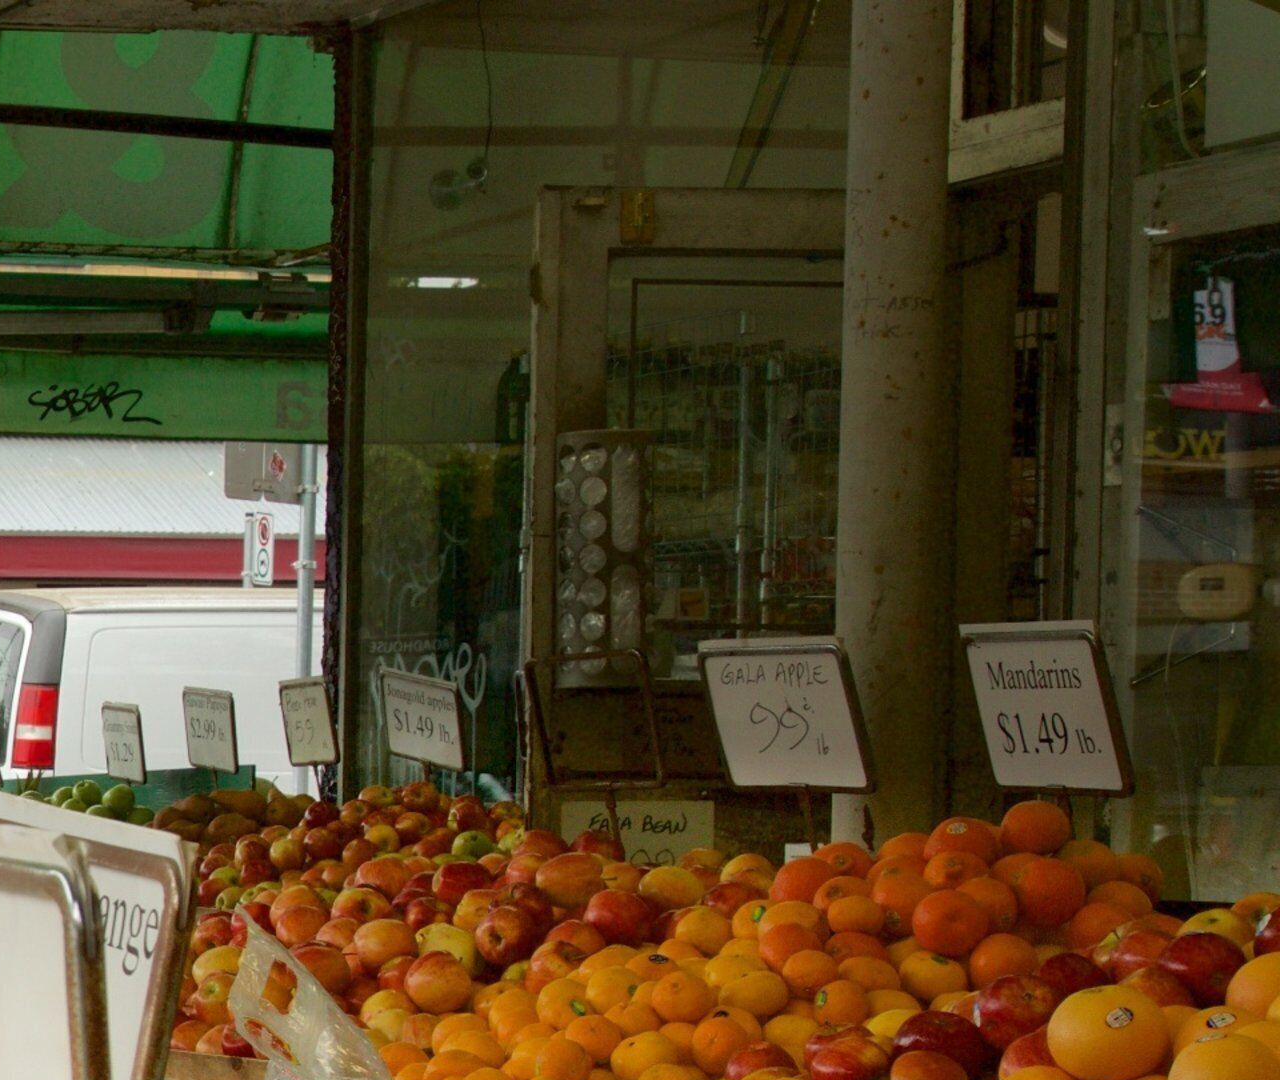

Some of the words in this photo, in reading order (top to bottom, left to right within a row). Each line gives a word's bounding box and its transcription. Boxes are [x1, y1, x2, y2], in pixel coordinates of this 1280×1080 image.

[720, 662, 766, 687] GALA
[774, 662, 829, 687] APPLE
[987, 661, 1083, 692] Mandarins
[190, 717, 216, 741] $2.99
[393, 710, 434, 739] $1.49
[437, 723, 455, 746] lb.
[998, 709, 1070, 757] $1.49
[1077, 728, 1103, 756] lb.
[642, 814, 689, 834] BEAN
